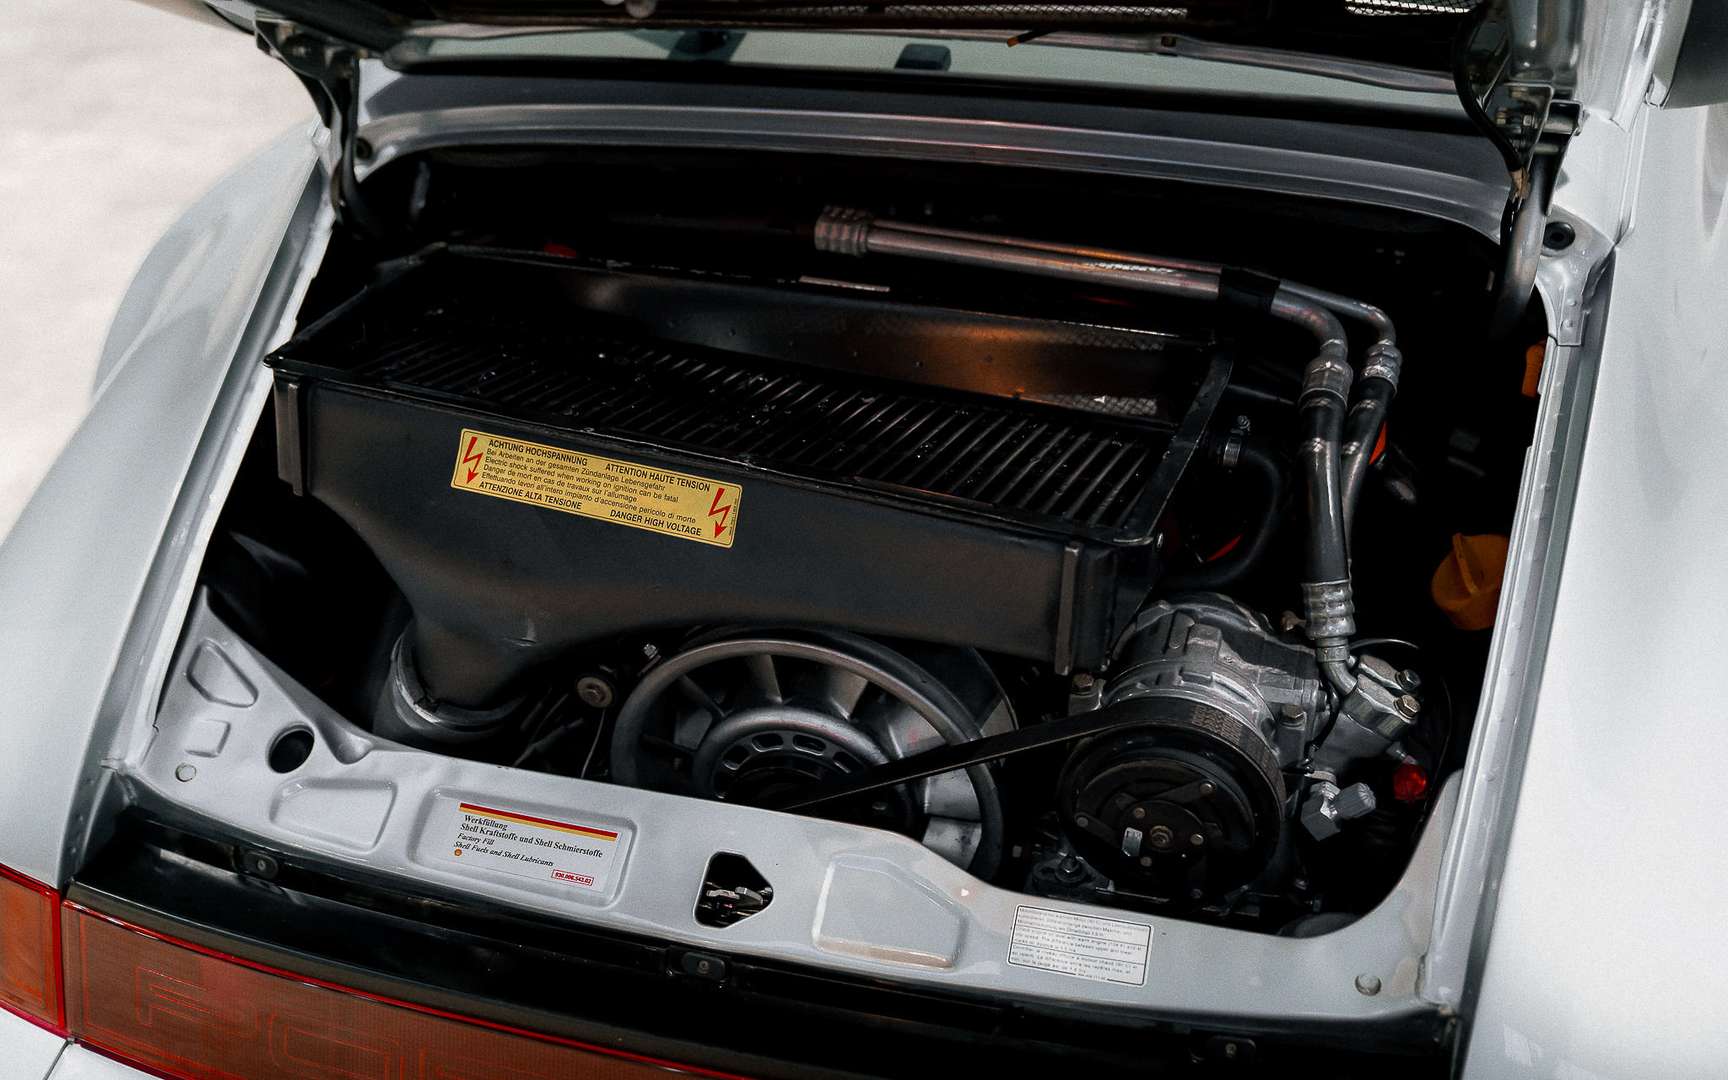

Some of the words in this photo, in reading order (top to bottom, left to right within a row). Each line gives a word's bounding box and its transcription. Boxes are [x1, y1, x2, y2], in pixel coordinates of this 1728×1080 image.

[489, 440, 524, 453] ACHTUNG
[525, 447, 588, 466] HOCHSPANNUNG
[484, 463, 507, 475] Danger
[508, 469, 516, 477] de
[516, 472, 533, 480] mort
[543, 477, 555, 485] cas
[566, 481, 591, 493] travaux
[485, 455, 508, 467] Electric
[509, 462, 528, 471] shock
[530, 466, 556, 477] suffered
[556, 472, 575, 480] when
[575, 476, 602, 488] working
[613, 484, 638, 495] ignition
[639, 489, 652, 497] can
[486, 448, 497, 456] Bei
[499, 450, 524, 462] Arbeiten
[536, 458, 546, 466] der
[547, 461, 580, 474] gesamten
[581, 467, 620, 482] Zündanlage
[621, 476, 666, 491] Lebensgefahr
[605, 463, 648, 479] ATTENTION
[649, 472, 675, 485] HAUTE
[676, 478, 711, 492] TENSION
[479, 481, 524, 498] ATTENZIONE
[524, 490, 543, 501] ALTA
[544, 495, 583, 510] TENSIONE
[481, 471, 517, 485] Effettuando
[564, 490, 593, 502] impianto
[639, 506, 667, 518] pericolo
[676, 514, 697, 524] morte
[610, 509, 643, 523] DANGER
[644, 516, 665, 528] HIGH
[666, 521, 703, 536] VOLTAGE
[464, 814, 508, 831] Werkfüllung
[457, 832, 481, 844] Factory
[482, 837, 496, 846] Fill
[460, 822, 479, 833] Shell
[480, 826, 518, 841] Kraftstoffe
[519, 836, 534, 844] und
[534, 837, 554, 848] Shell
[553, 841, 603, 858] Schmierstoffe
[453, 841, 471, 850] Shell
[471, 845, 489, 854] Fuels
[489, 849, 503, 857] and
[502, 851, 521, 860] Shell
[520, 854, 554, 867] Lubricants
